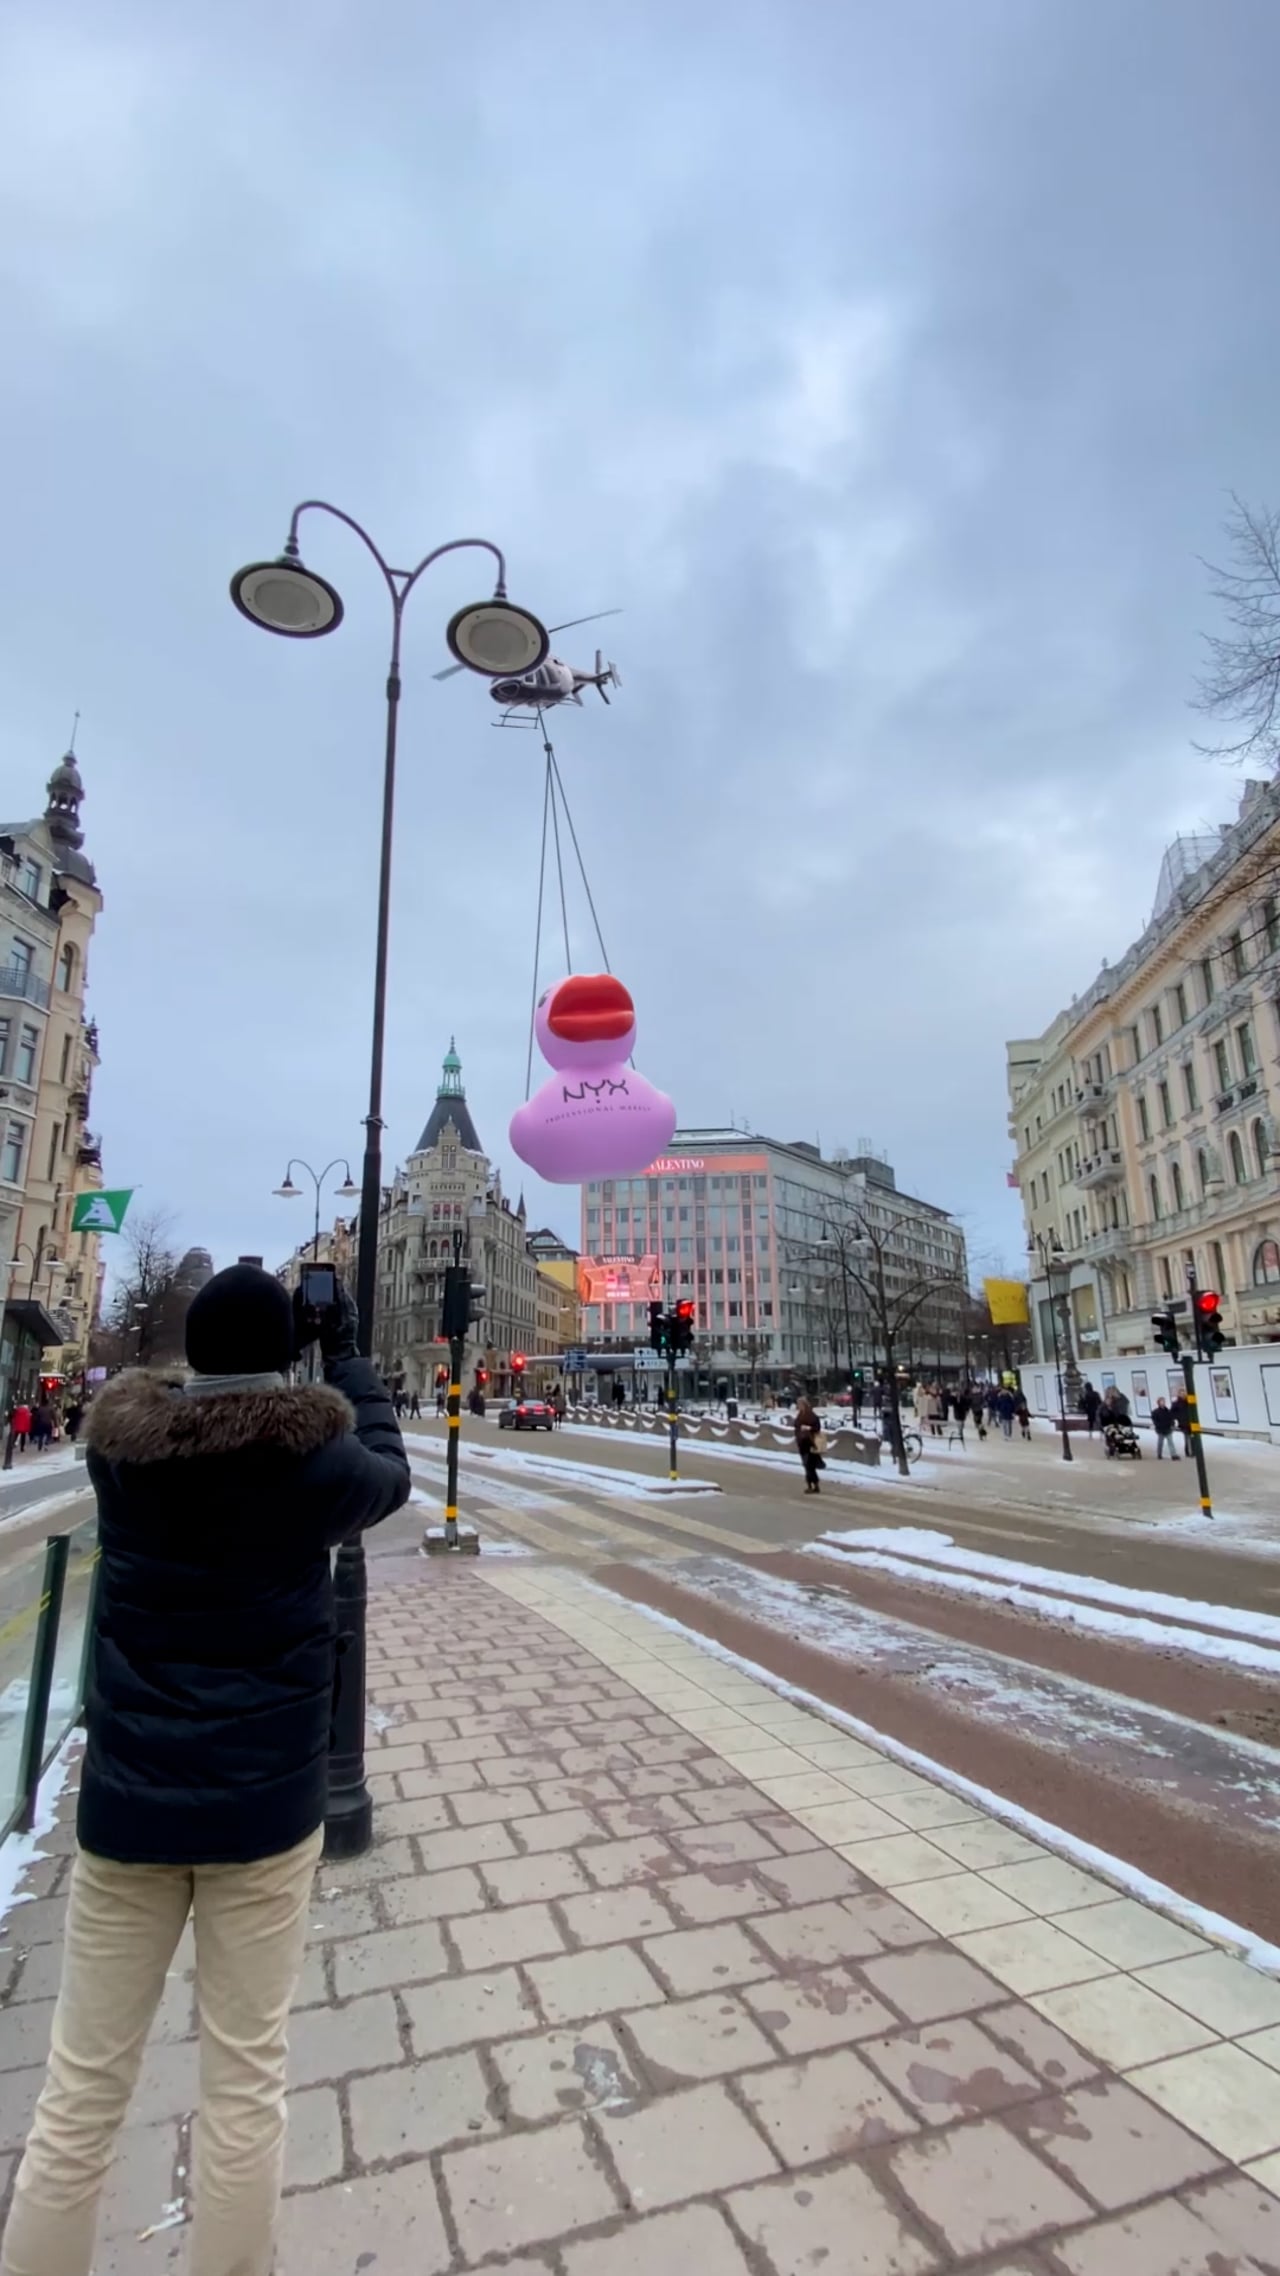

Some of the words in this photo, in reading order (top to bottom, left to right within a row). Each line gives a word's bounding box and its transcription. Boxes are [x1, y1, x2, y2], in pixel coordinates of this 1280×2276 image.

[563, 1078, 629, 1104] NYX
[545, 1106, 614, 1124] PROFESSIONAL
[602, 1256, 635, 1264] VALENTINO
